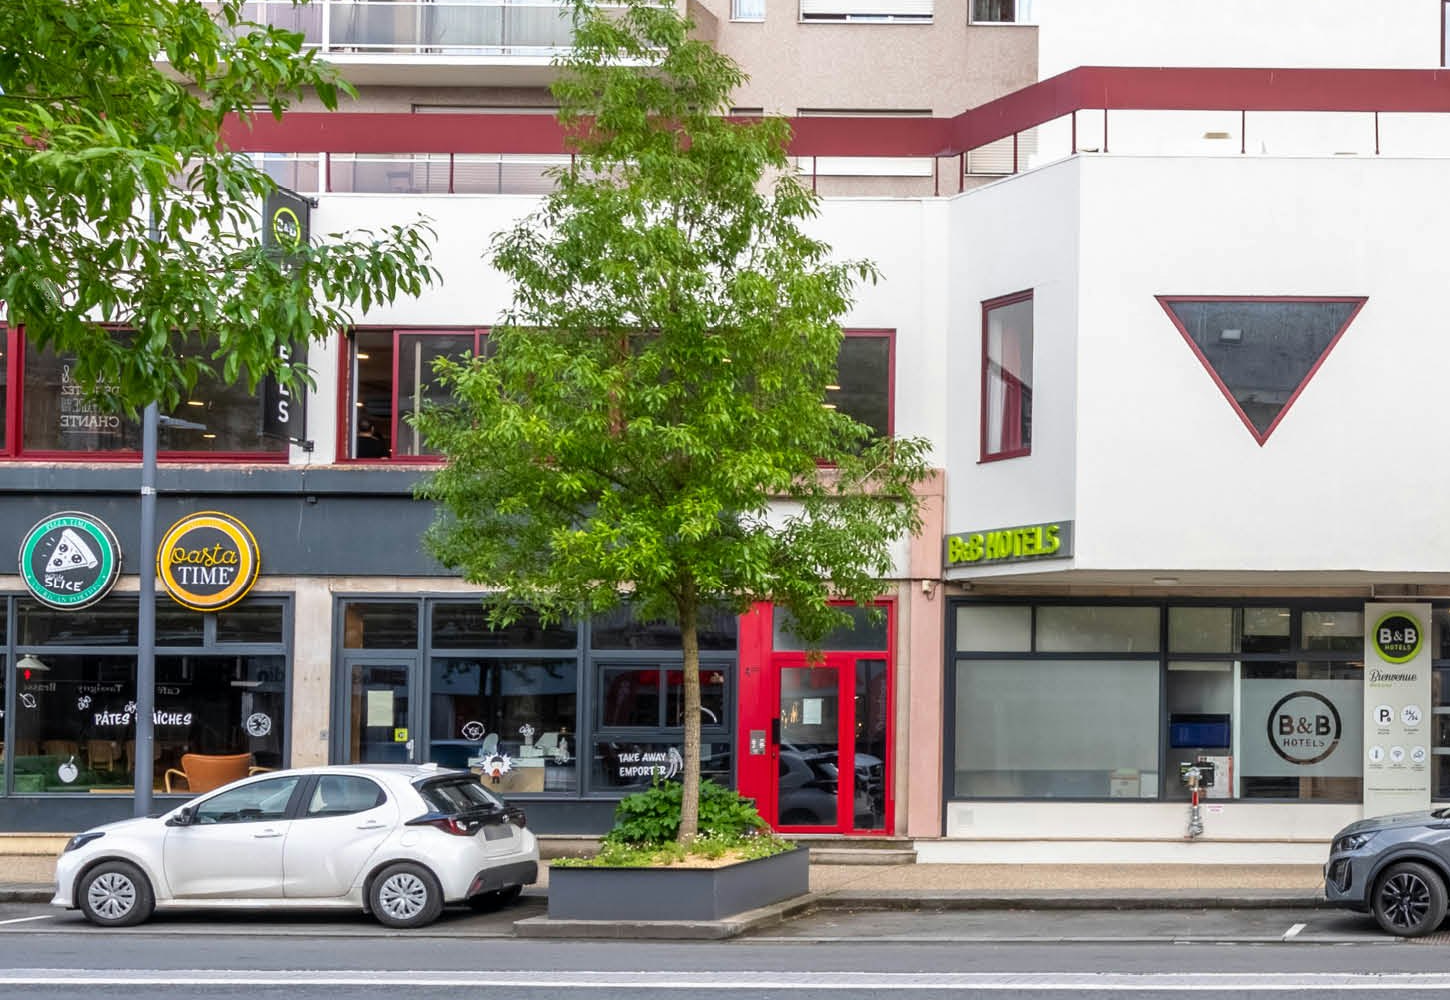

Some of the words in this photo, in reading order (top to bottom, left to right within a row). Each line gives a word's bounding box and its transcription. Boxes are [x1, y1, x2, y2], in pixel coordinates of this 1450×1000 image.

[948, 534, 984, 563] B&B
[985, 525, 1061, 559] HOTELS
[171, 543, 238, 567] pasta
[178, 566, 231, 585] TIME
[44, 578, 84, 592] SLICE
[1380, 628, 1417, 643] B&B
[1369, 668, 1417, 681] Bienvenue
[95, 710, 130, 725] PÂTES
[1279, 714, 1331, 735] B&B
[1283, 738, 1325, 747] HOTELS
[618, 753, 640, 763] TAKE
[642, 752, 666, 761] AWAY
